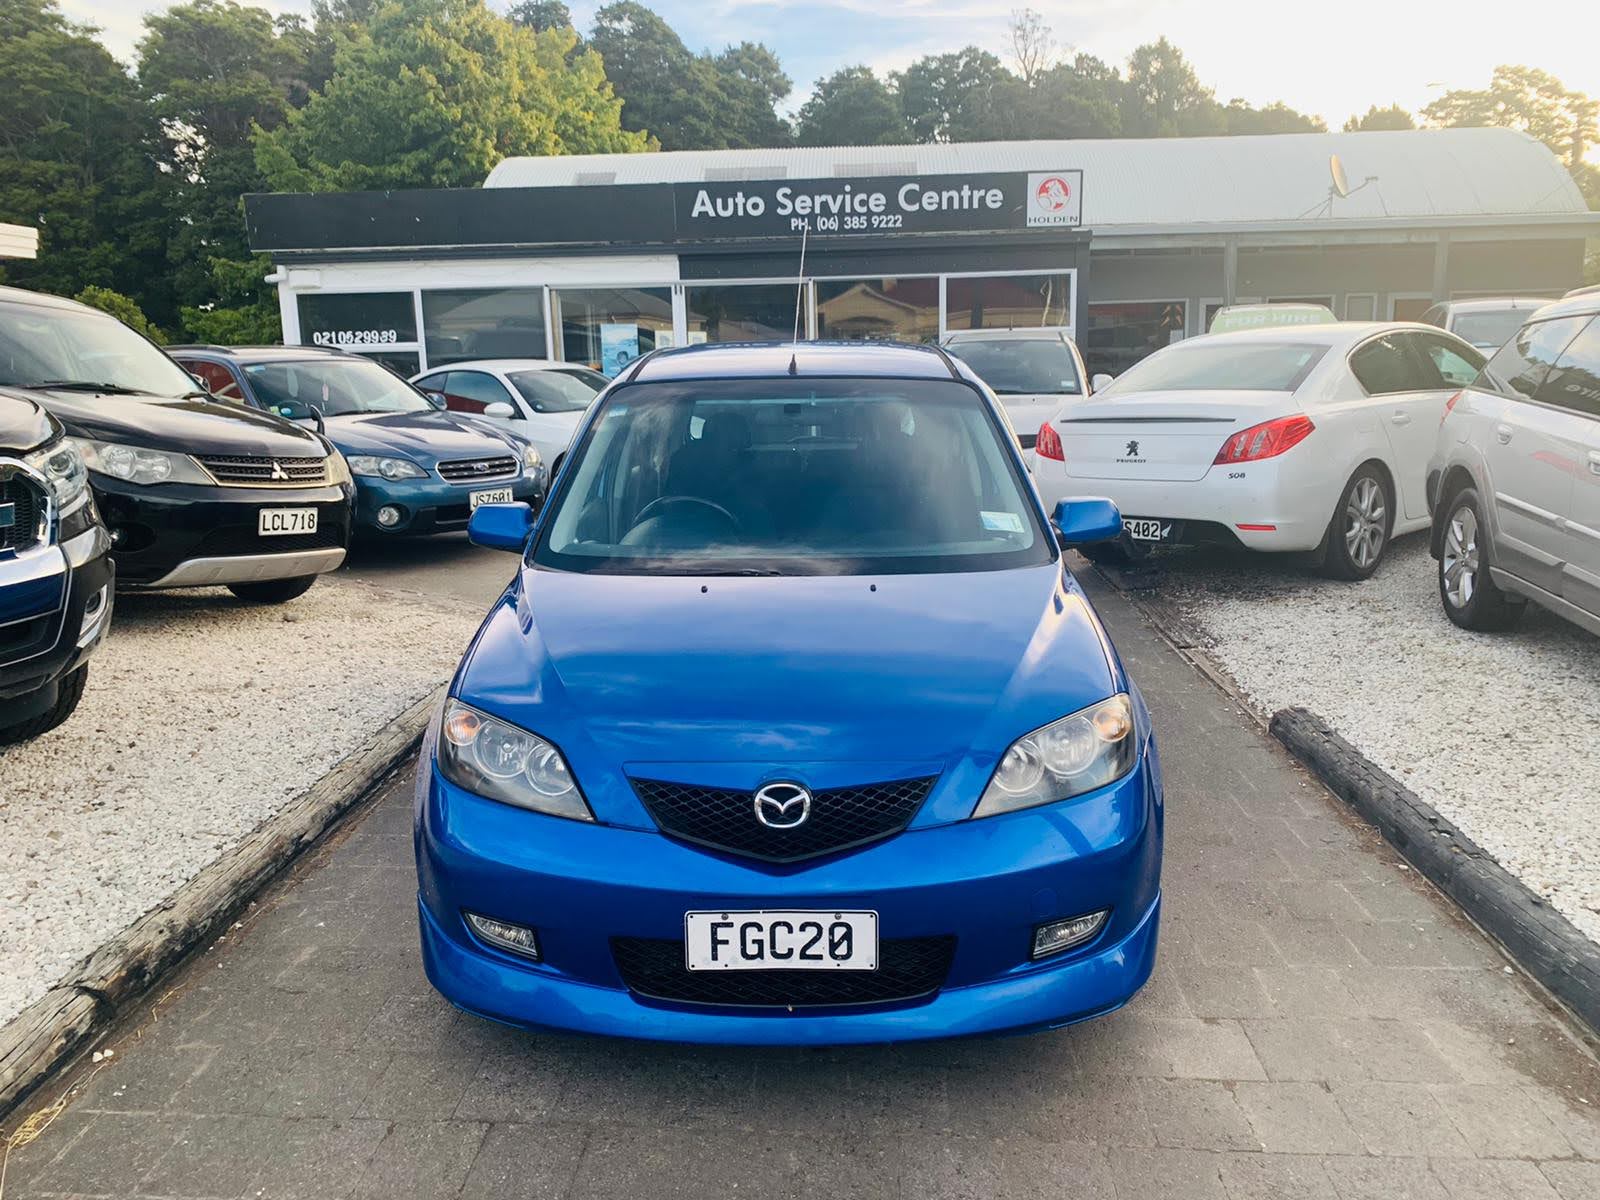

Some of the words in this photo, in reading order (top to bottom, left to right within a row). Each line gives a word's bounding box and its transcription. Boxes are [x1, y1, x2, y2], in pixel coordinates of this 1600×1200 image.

[691, 190, 765, 217] Auto
[775, 184, 886, 216] Service
[898, 183, 1004, 212] Centre
[791, 217, 812, 230] PH.
[816, 215, 839, 231] (06)
[843, 216, 867, 229] 385
[871, 215, 903, 228] 9222
[1028, 215, 1079, 224] HOLDEN
[262, 513, 315, 531] LCL718
[1124, 521, 1159, 538] S402
[710, 920, 853, 961] FGC20
